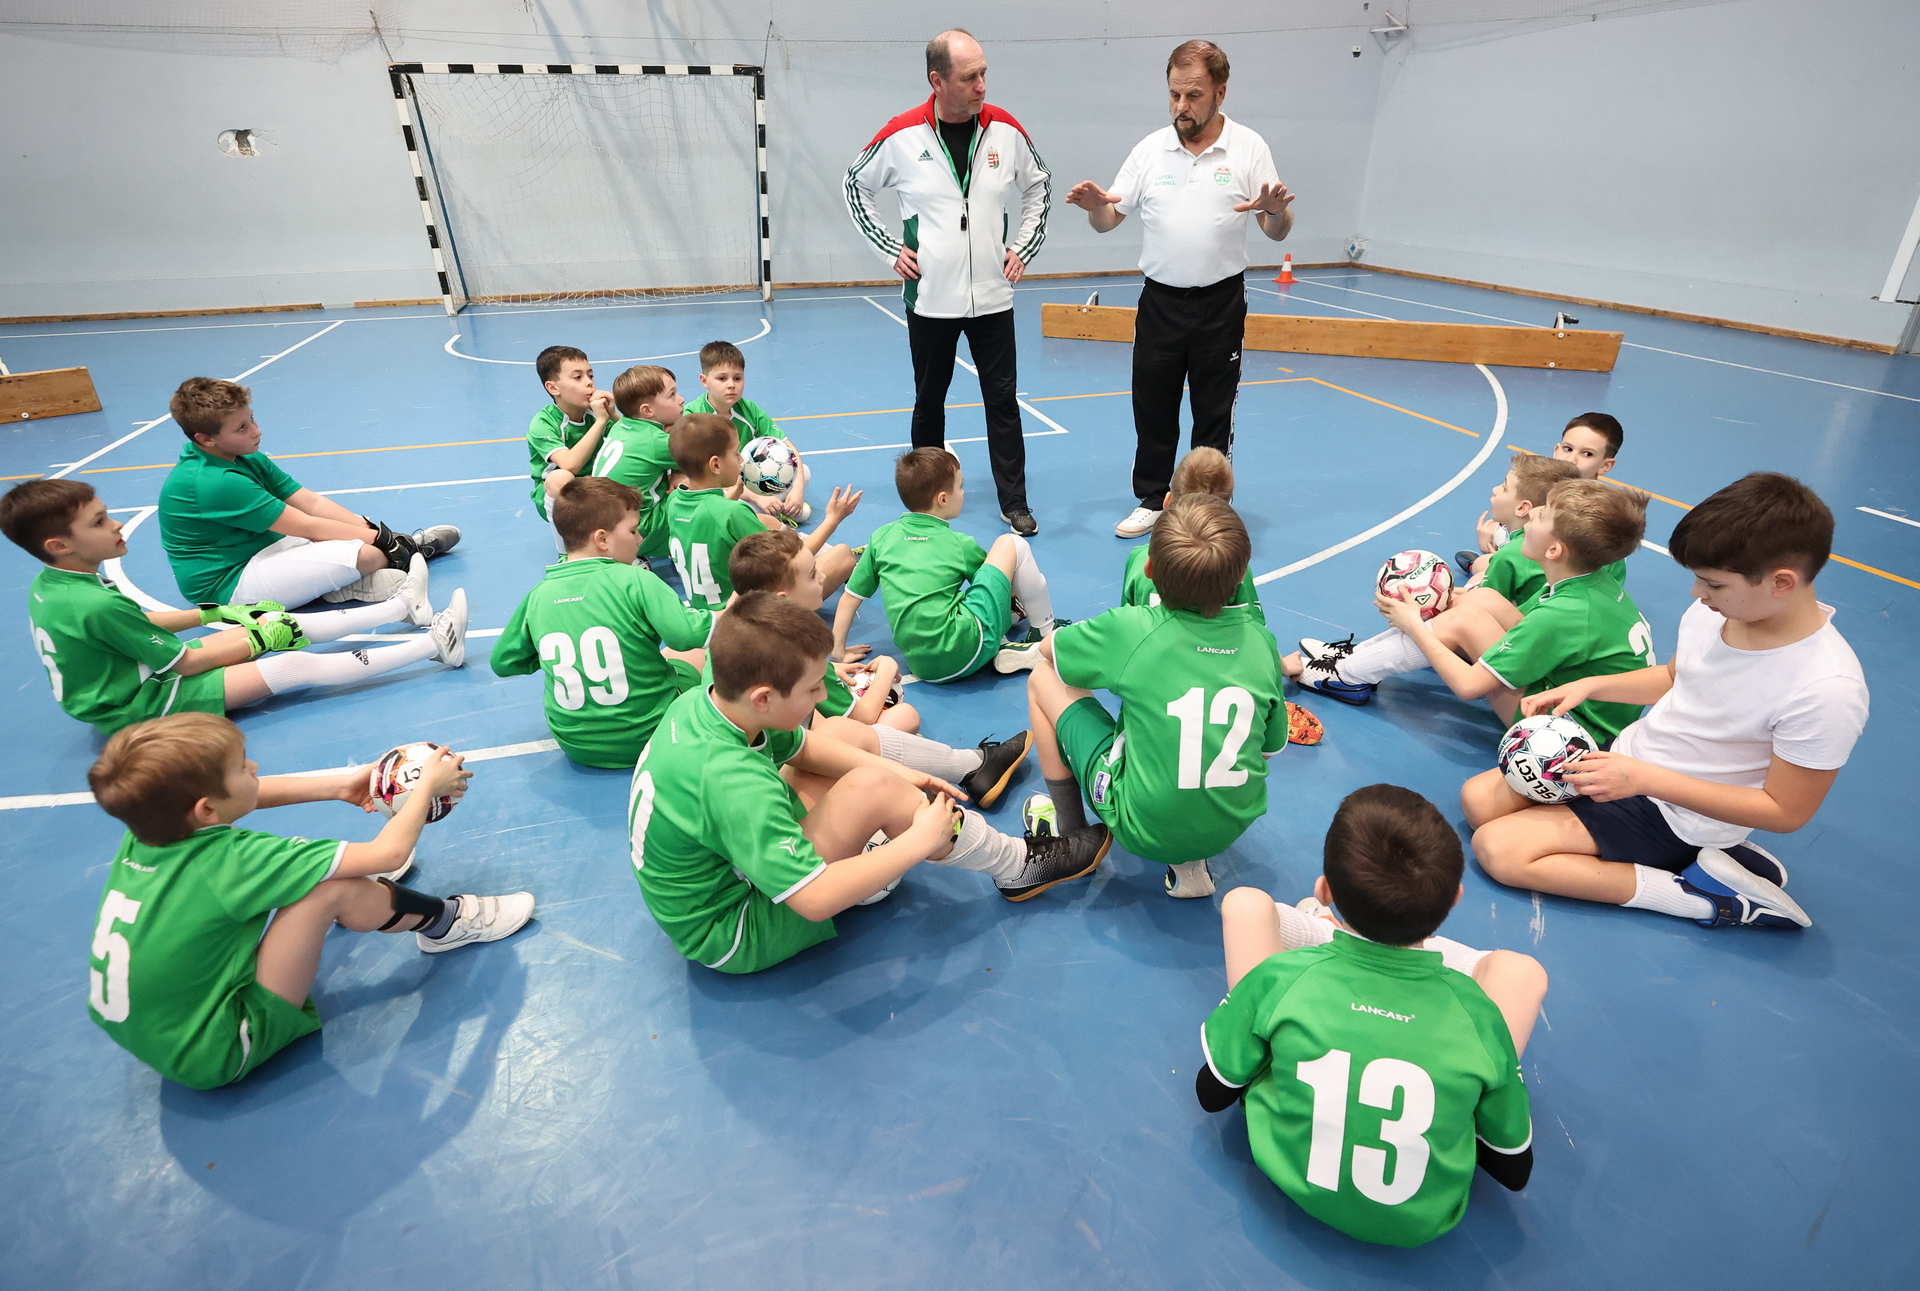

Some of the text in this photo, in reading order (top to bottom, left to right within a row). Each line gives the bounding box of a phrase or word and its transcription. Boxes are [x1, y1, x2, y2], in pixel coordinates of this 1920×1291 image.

[29, 615, 63, 703] 6
[538, 625, 630, 711] 39
[1197, 646, 1238, 655] LANCAST
[1166, 685, 1256, 790] 12
[1515, 758, 1557, 800] SELECT
[89, 888, 143, 1024] 5
[1350, 1002, 1416, 1024] LANCAST
[1295, 1047, 1437, 1207] 13
